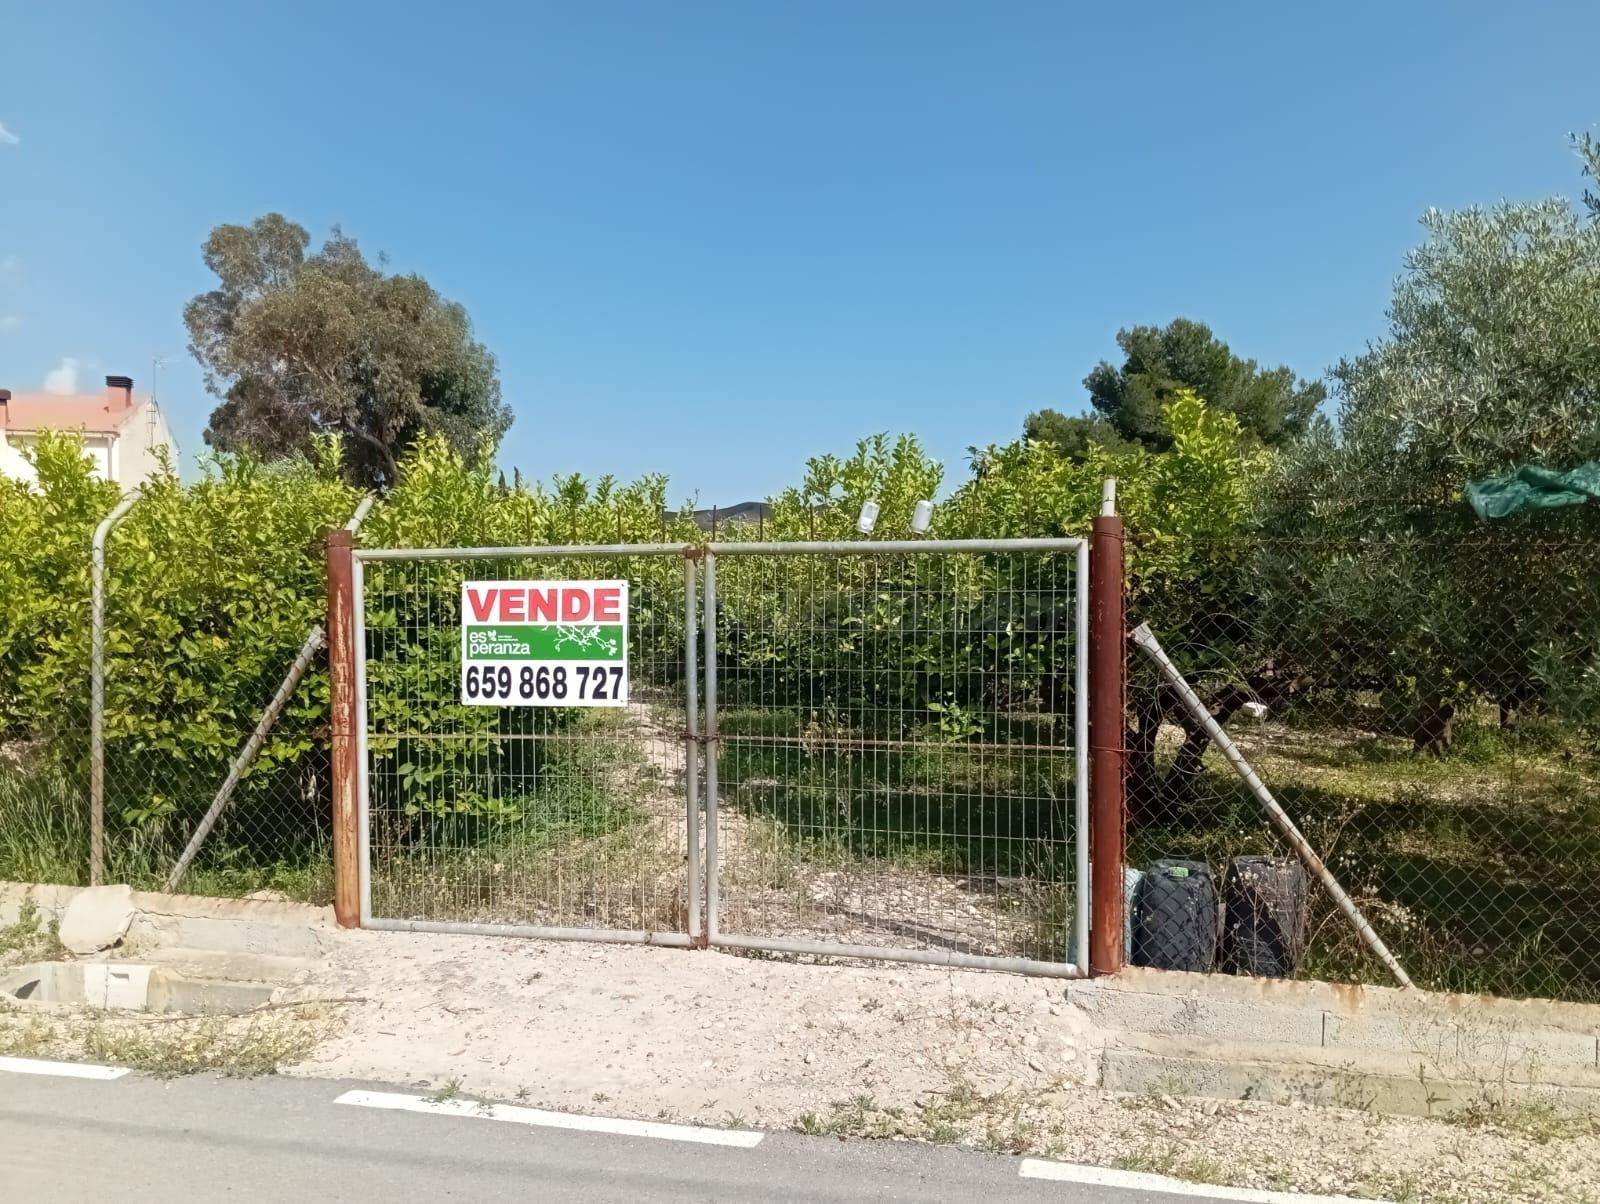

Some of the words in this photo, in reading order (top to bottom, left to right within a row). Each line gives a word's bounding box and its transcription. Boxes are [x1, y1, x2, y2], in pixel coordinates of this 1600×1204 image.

[466, 588, 621, 622] VENDE
[469, 631, 487, 642] es
[469, 642, 531, 658] peranza
[466, 666, 512, 699] 659
[519, 666, 568, 699] 868
[576, 666, 624, 700] 727
